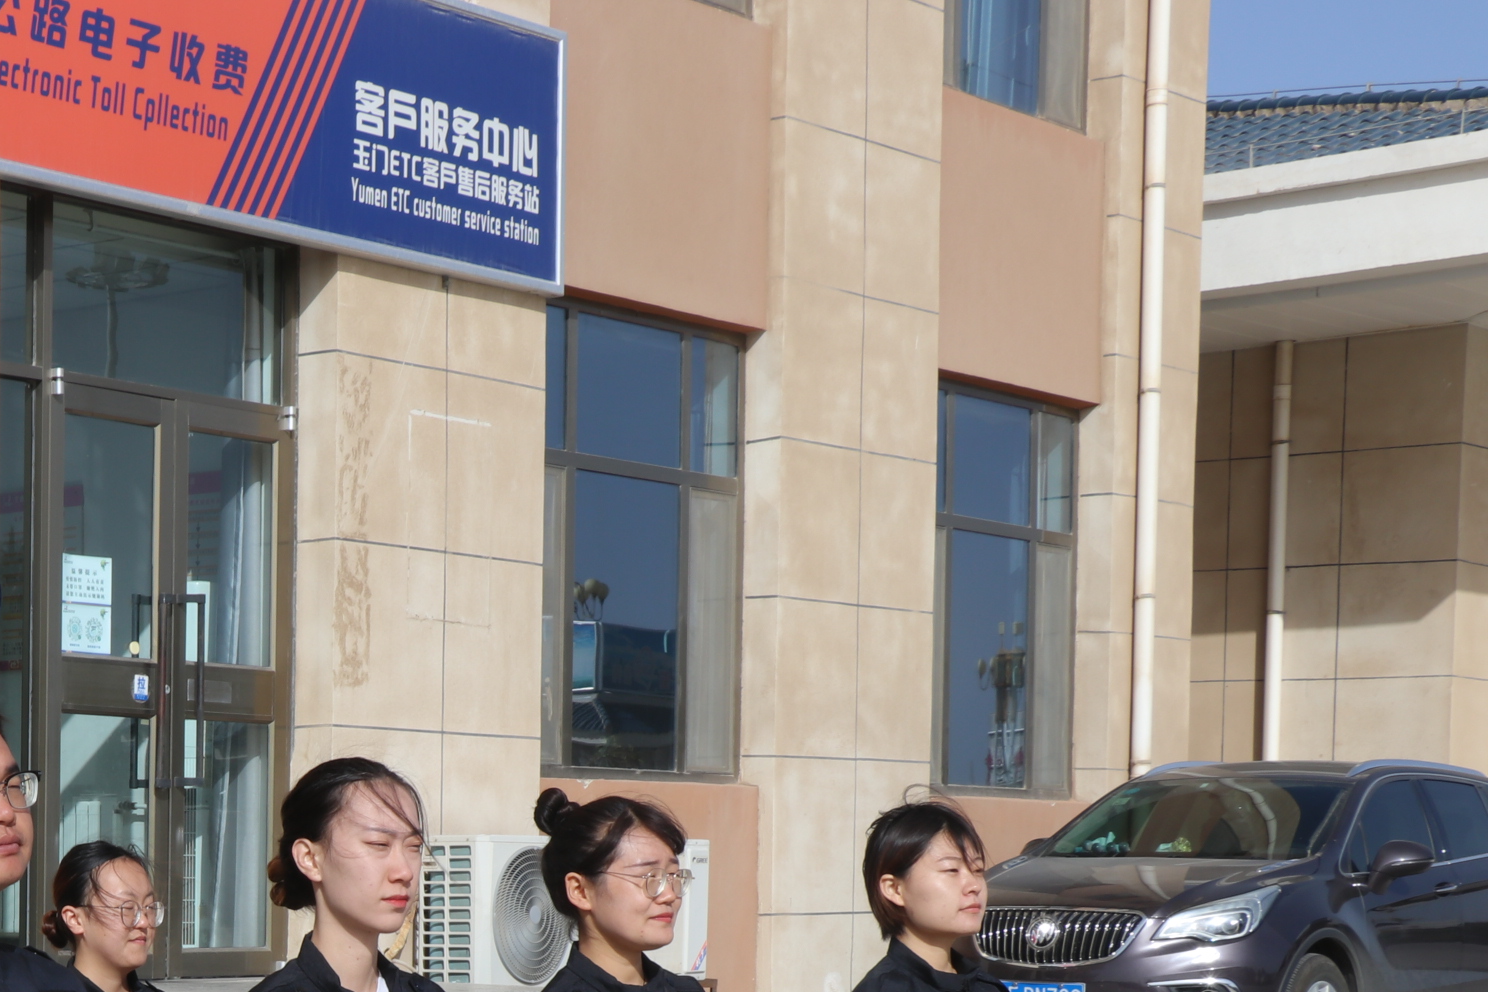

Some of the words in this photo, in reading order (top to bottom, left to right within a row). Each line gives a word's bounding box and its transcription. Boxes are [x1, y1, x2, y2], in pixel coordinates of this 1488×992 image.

[90, 75, 125, 116] Toll
[354, 79, 539, 178] 客户服务中心
[351, 177, 388, 209] Yumen
[391, 187, 411, 214] ETC
[413, 196, 462, 227] customer
[464, 209, 501, 236] service
[504, 216, 540, 246] station
[352, 138, 540, 215] 玉门ETC客户售后服务站
